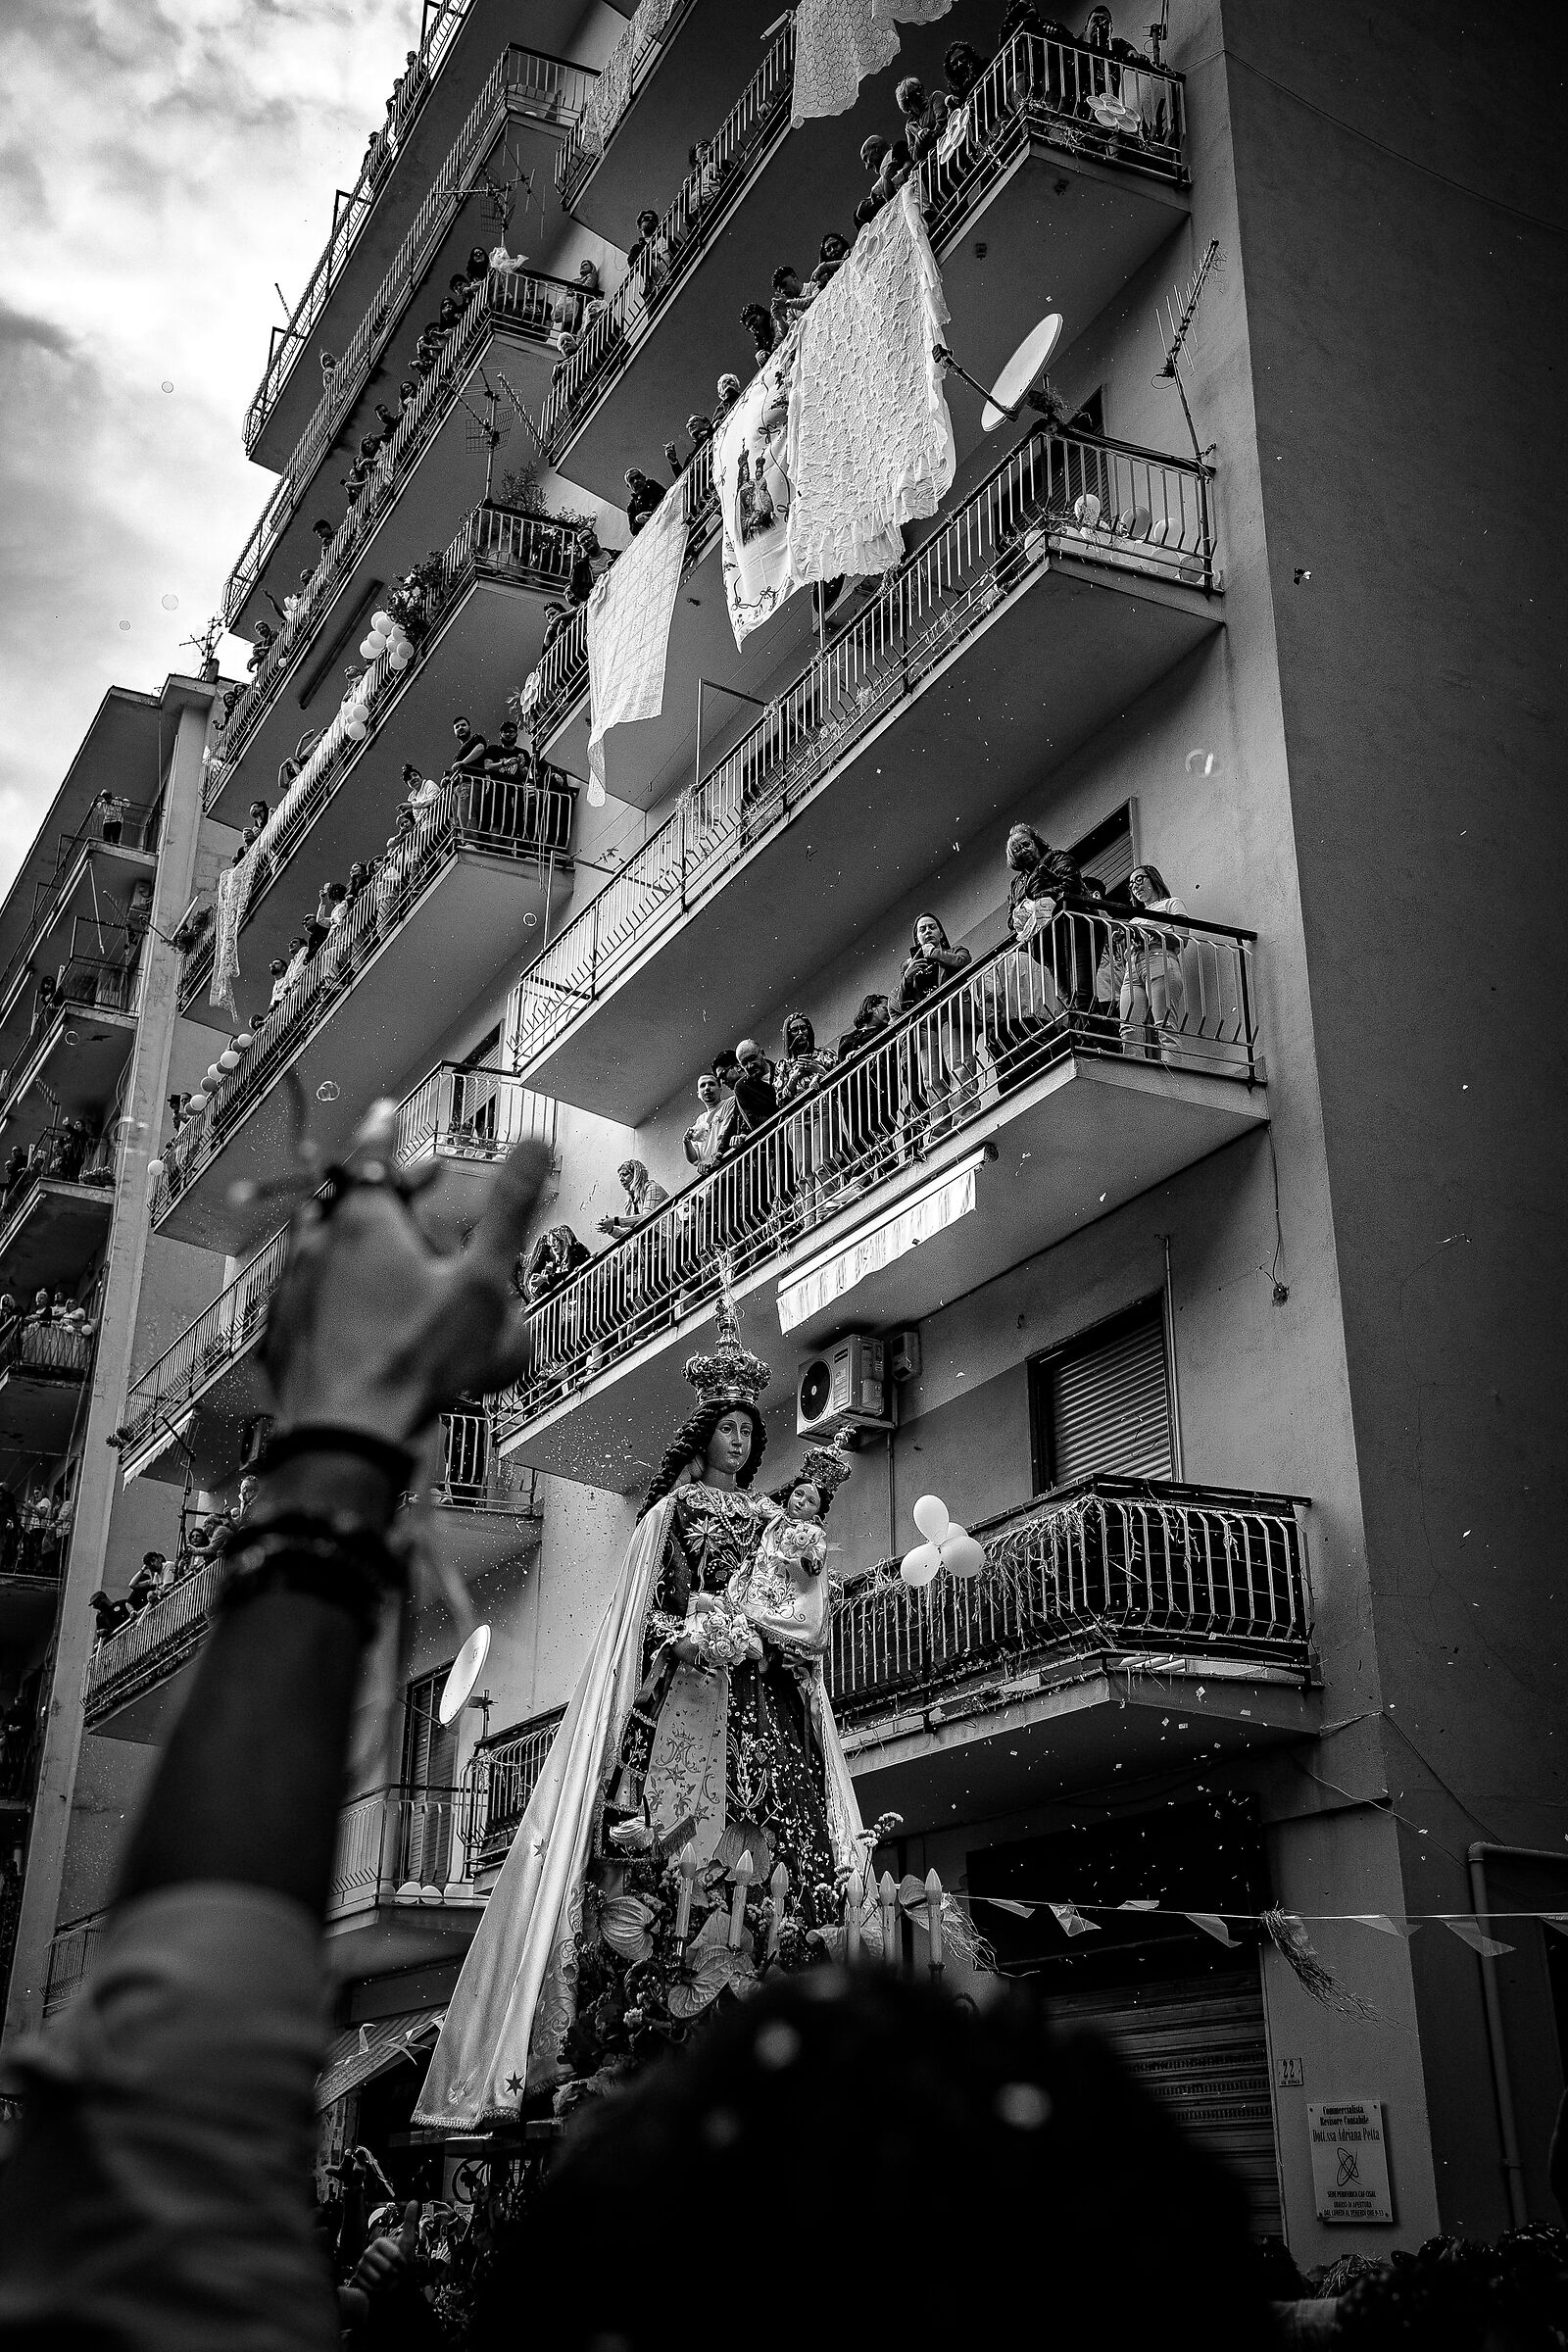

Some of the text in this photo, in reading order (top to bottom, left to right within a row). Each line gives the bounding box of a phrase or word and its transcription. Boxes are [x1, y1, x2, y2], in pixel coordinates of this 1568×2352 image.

[1283, 2060, 1295, 2078] 22
[1323, 2105, 1364, 2115] Commercialista
[1320, 2115, 1369, 2126] Revisore Contabile
[1313, 2130, 1337, 2142] Dott.ssa
[1338, 2128, 1362, 2141] Adriana
